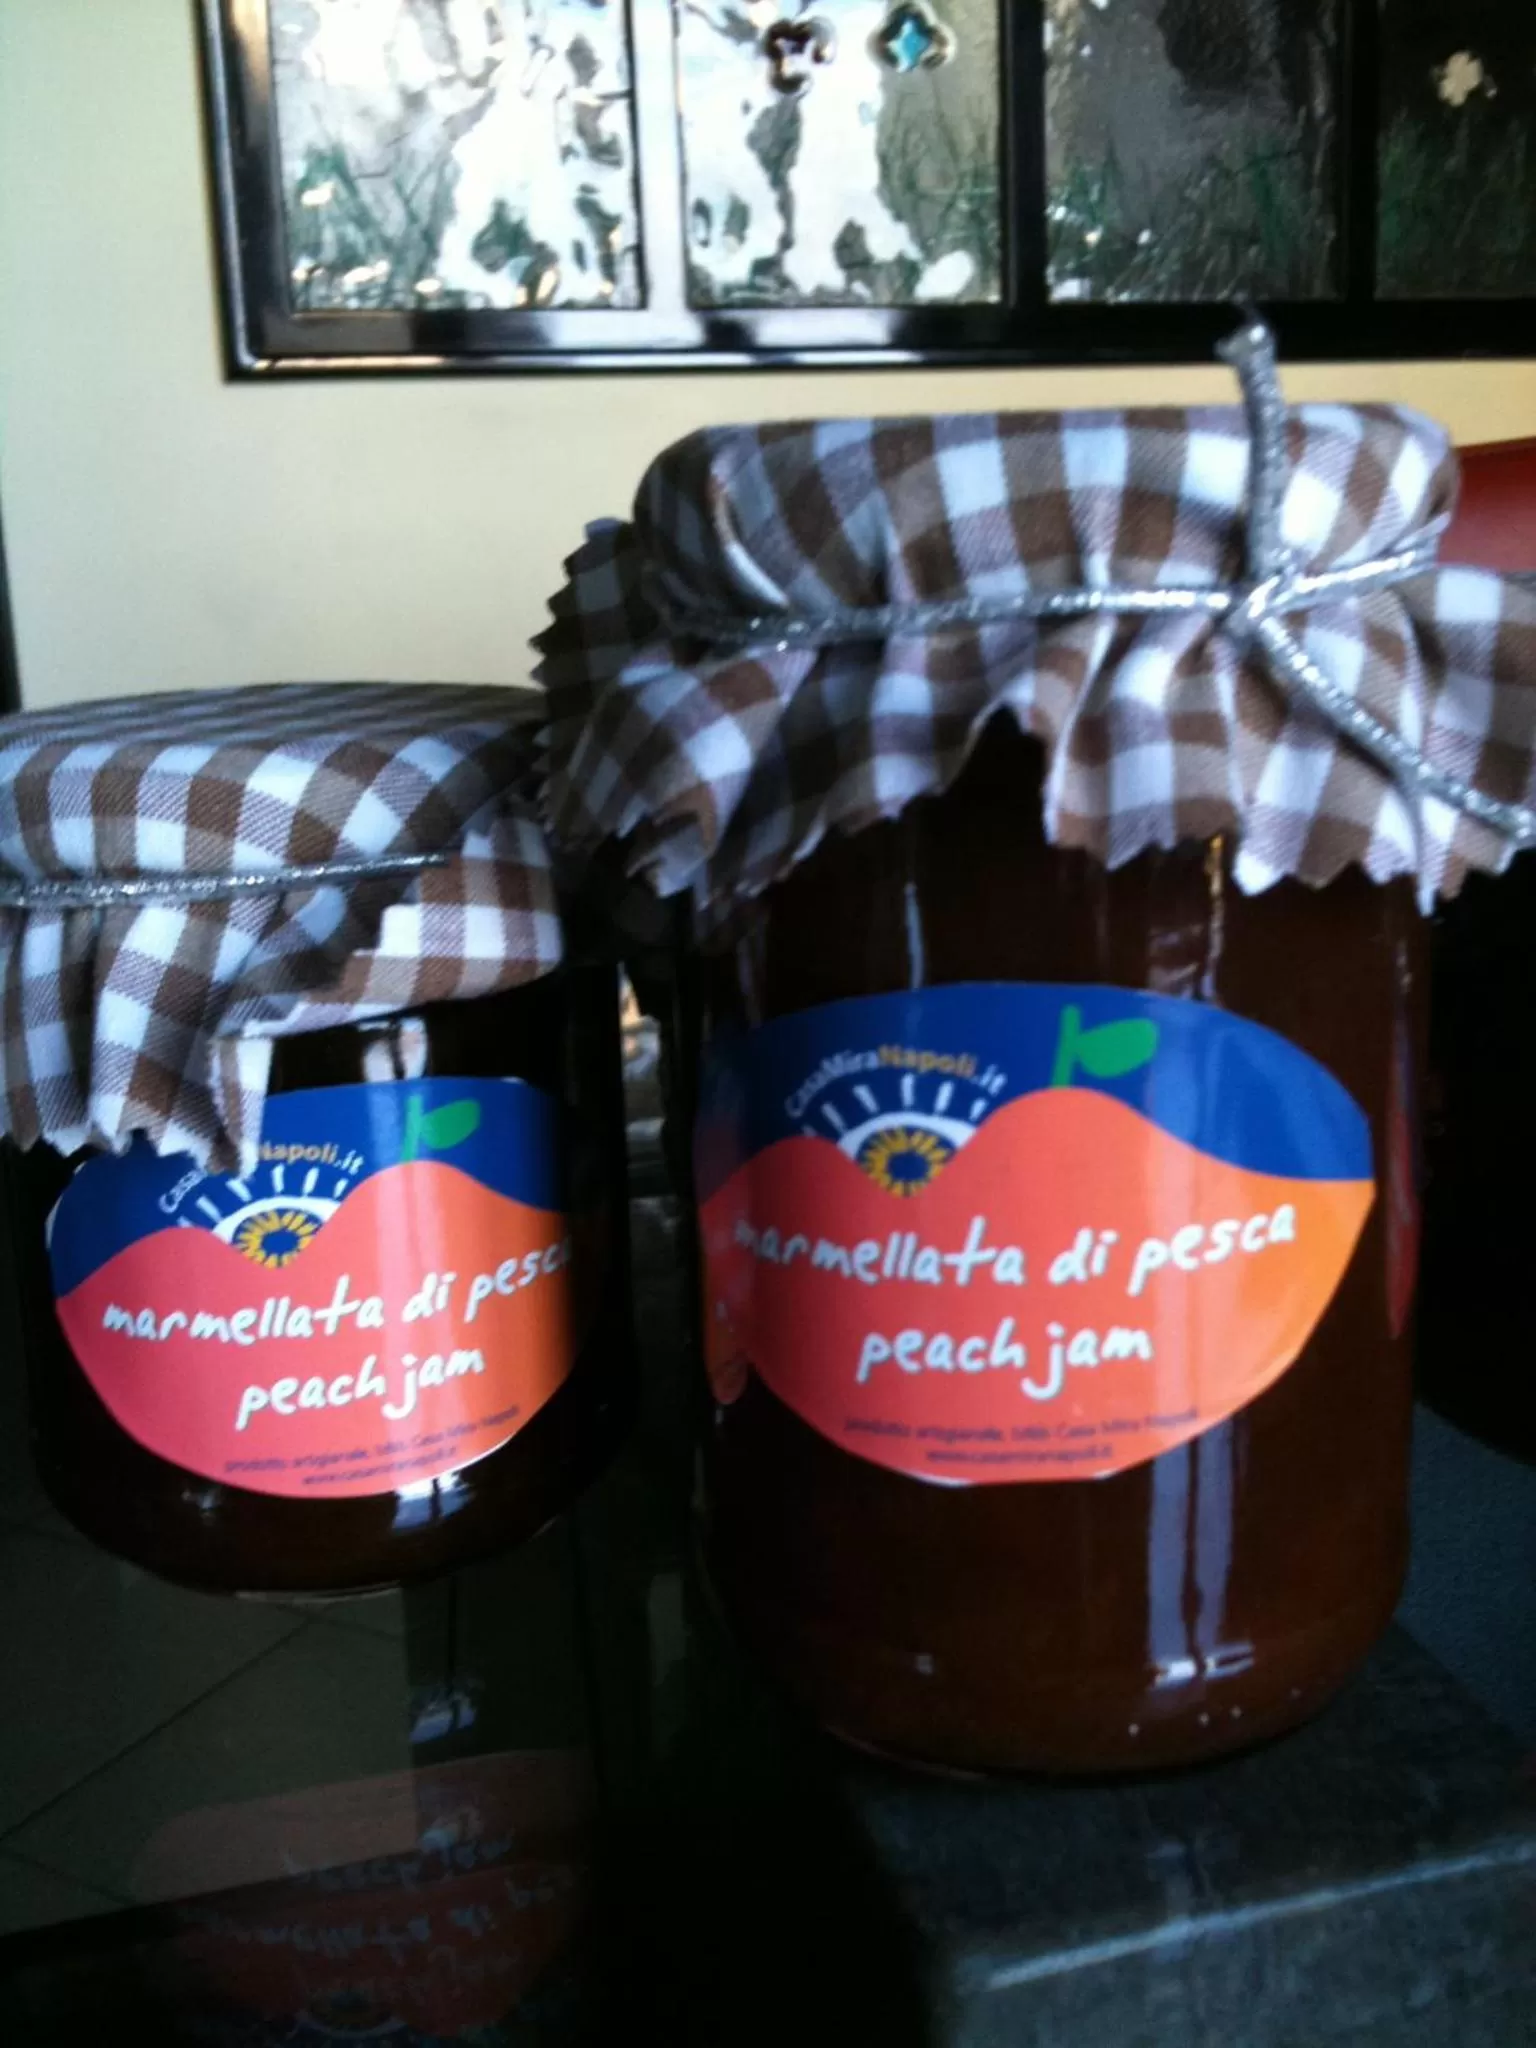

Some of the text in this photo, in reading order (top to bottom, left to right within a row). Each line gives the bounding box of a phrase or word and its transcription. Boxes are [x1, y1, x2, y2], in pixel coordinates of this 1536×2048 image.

[735, 1203, 1296, 1297] marmellata di pesca
[102, 1274, 385, 1346] marmellata
[401, 1271, 457, 1323] di
[234, 1354, 387, 1431] peach
[381, 1348, 486, 1419] jam
[856, 1316, 1154, 1400] peach jam
